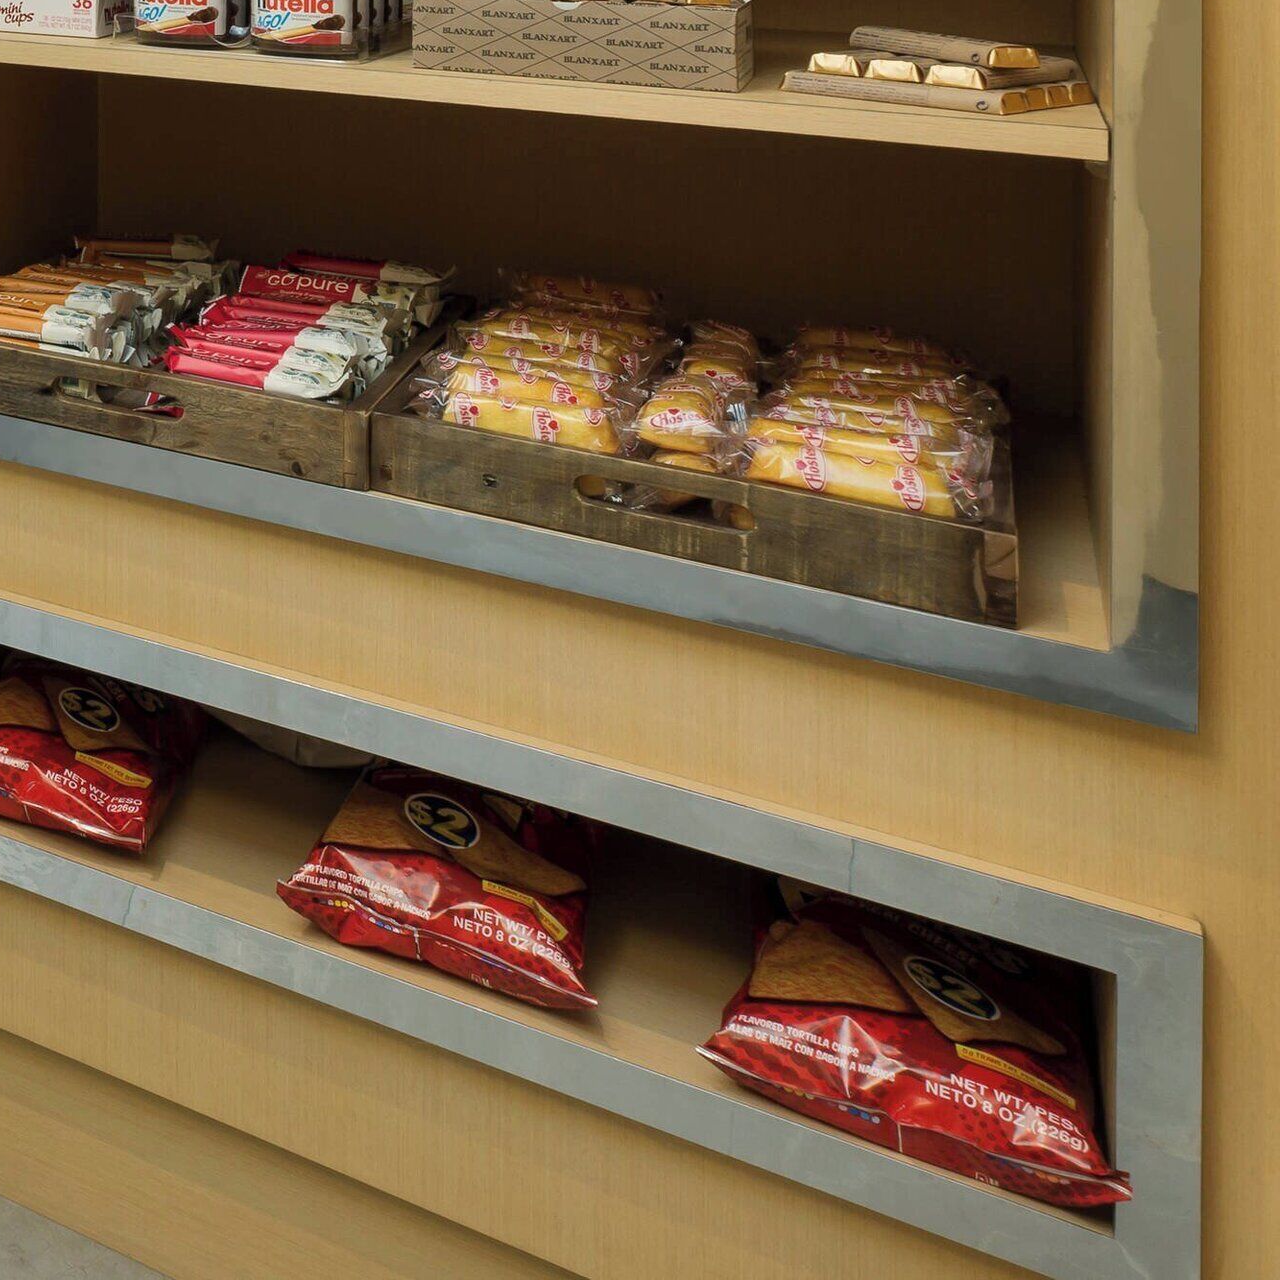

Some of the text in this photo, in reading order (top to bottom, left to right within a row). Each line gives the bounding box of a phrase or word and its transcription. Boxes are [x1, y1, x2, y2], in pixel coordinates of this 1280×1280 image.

[5, 11, 35, 27] cups
[482, 9, 535, 21] BLANXART
[45, 771, 77, 790] NETO
[89, 793, 105, 807] OZ
[63, 768, 142, 806] NET PESO
[474, 908, 502, 925] NET
[453, 916, 530, 950] NETO 8 OZ
[757, 1031, 768, 1041] DE
[795, 1043, 813, 1056] CON
[787, 1026, 830, 1047] TORTILLA
[950, 1074, 989, 1095] NET
[926, 1080, 1089, 1153] NETO 8 (226g)
